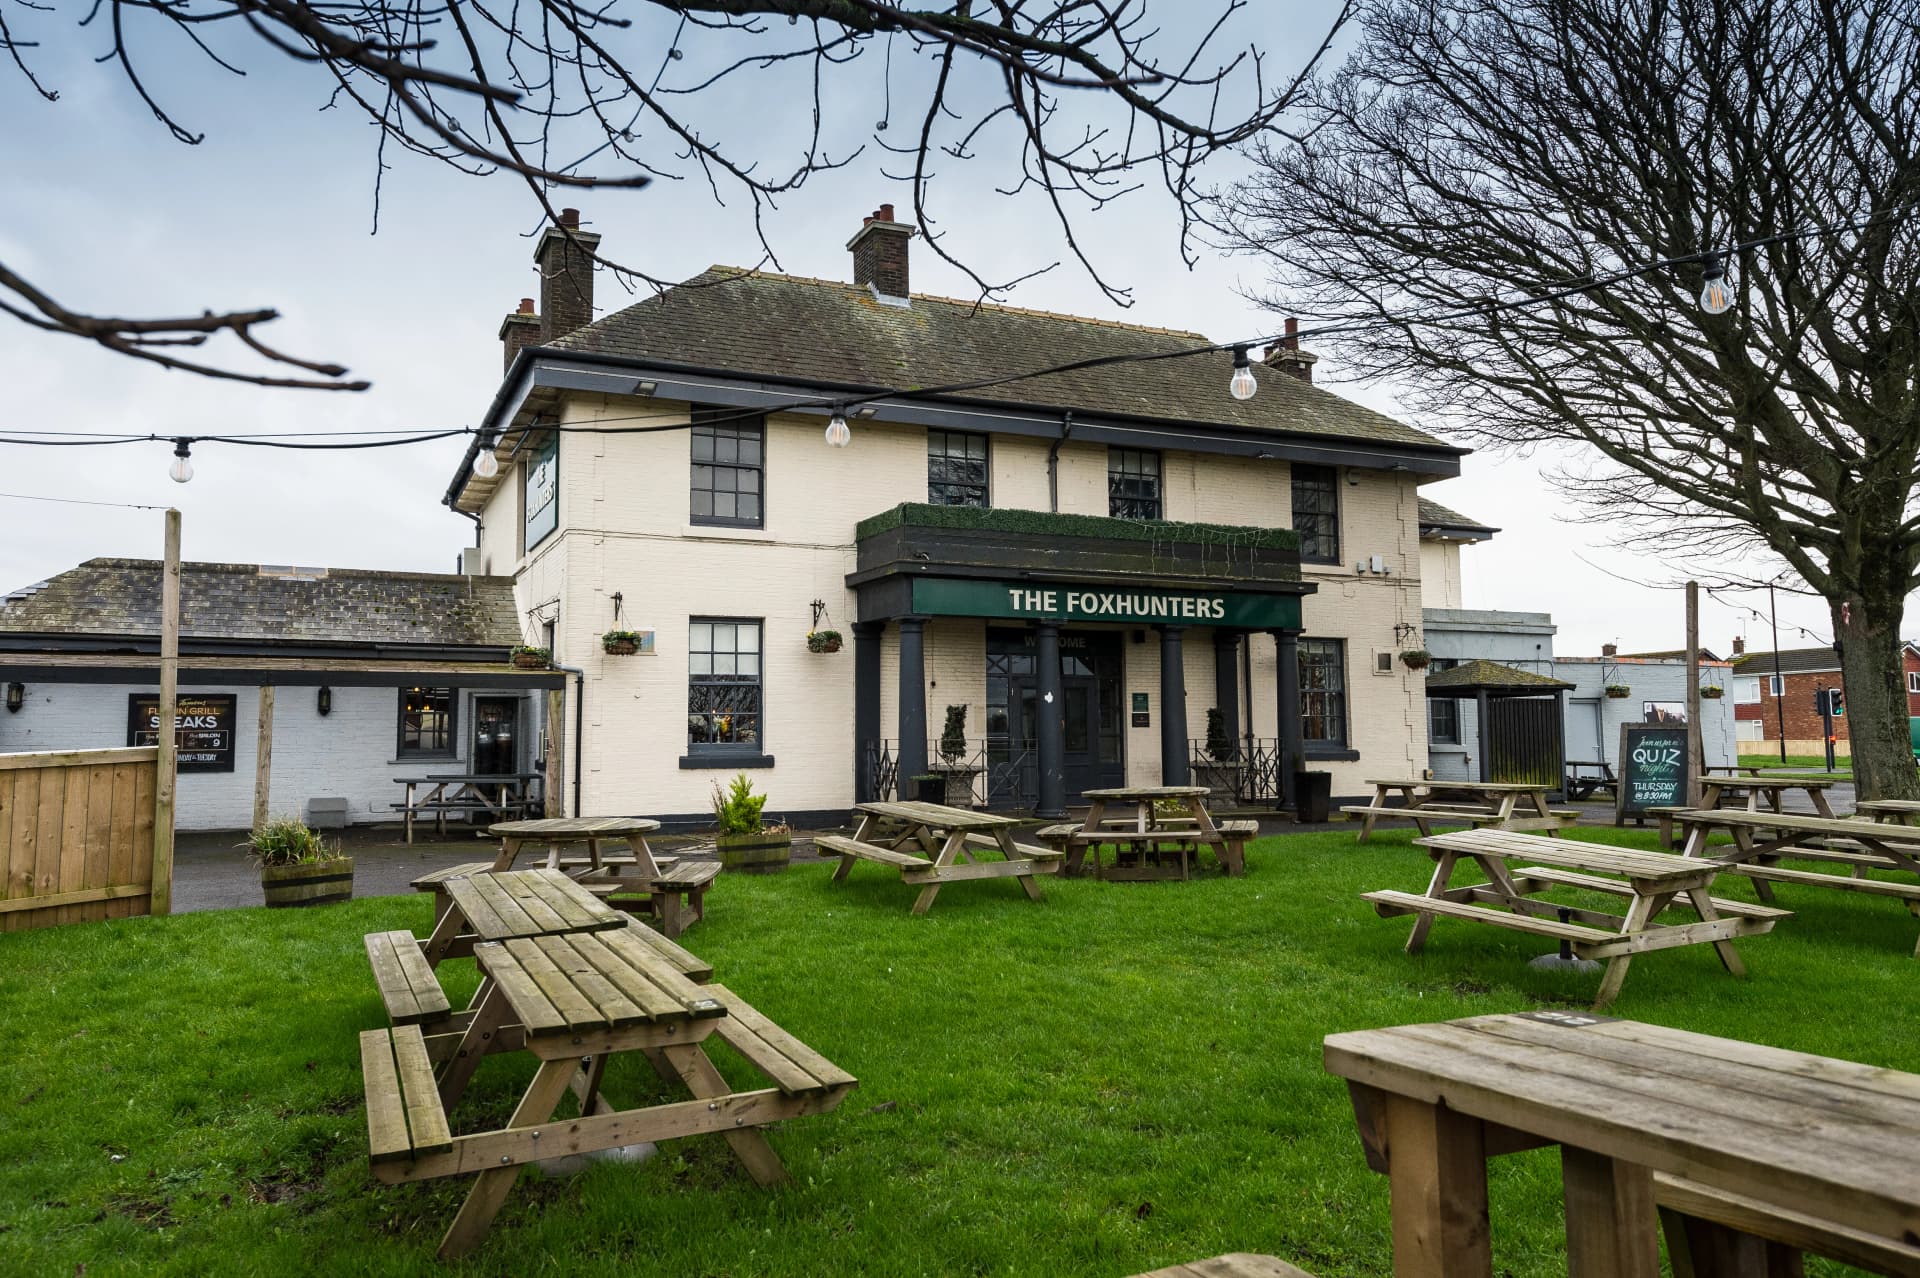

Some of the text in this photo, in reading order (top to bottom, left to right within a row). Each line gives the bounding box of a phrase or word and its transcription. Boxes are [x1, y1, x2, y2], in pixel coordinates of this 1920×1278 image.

[1009, 589, 1225, 619] THE FOXHUNTERS
[1024, 635, 1087, 649] WOME
[148, 707, 221, 715] FLIN GRILL
[150, 716, 218, 728] SEAKS
[1632, 748, 1681, 766] QUIZ
[1633, 782, 1678, 791] THURSDAY
